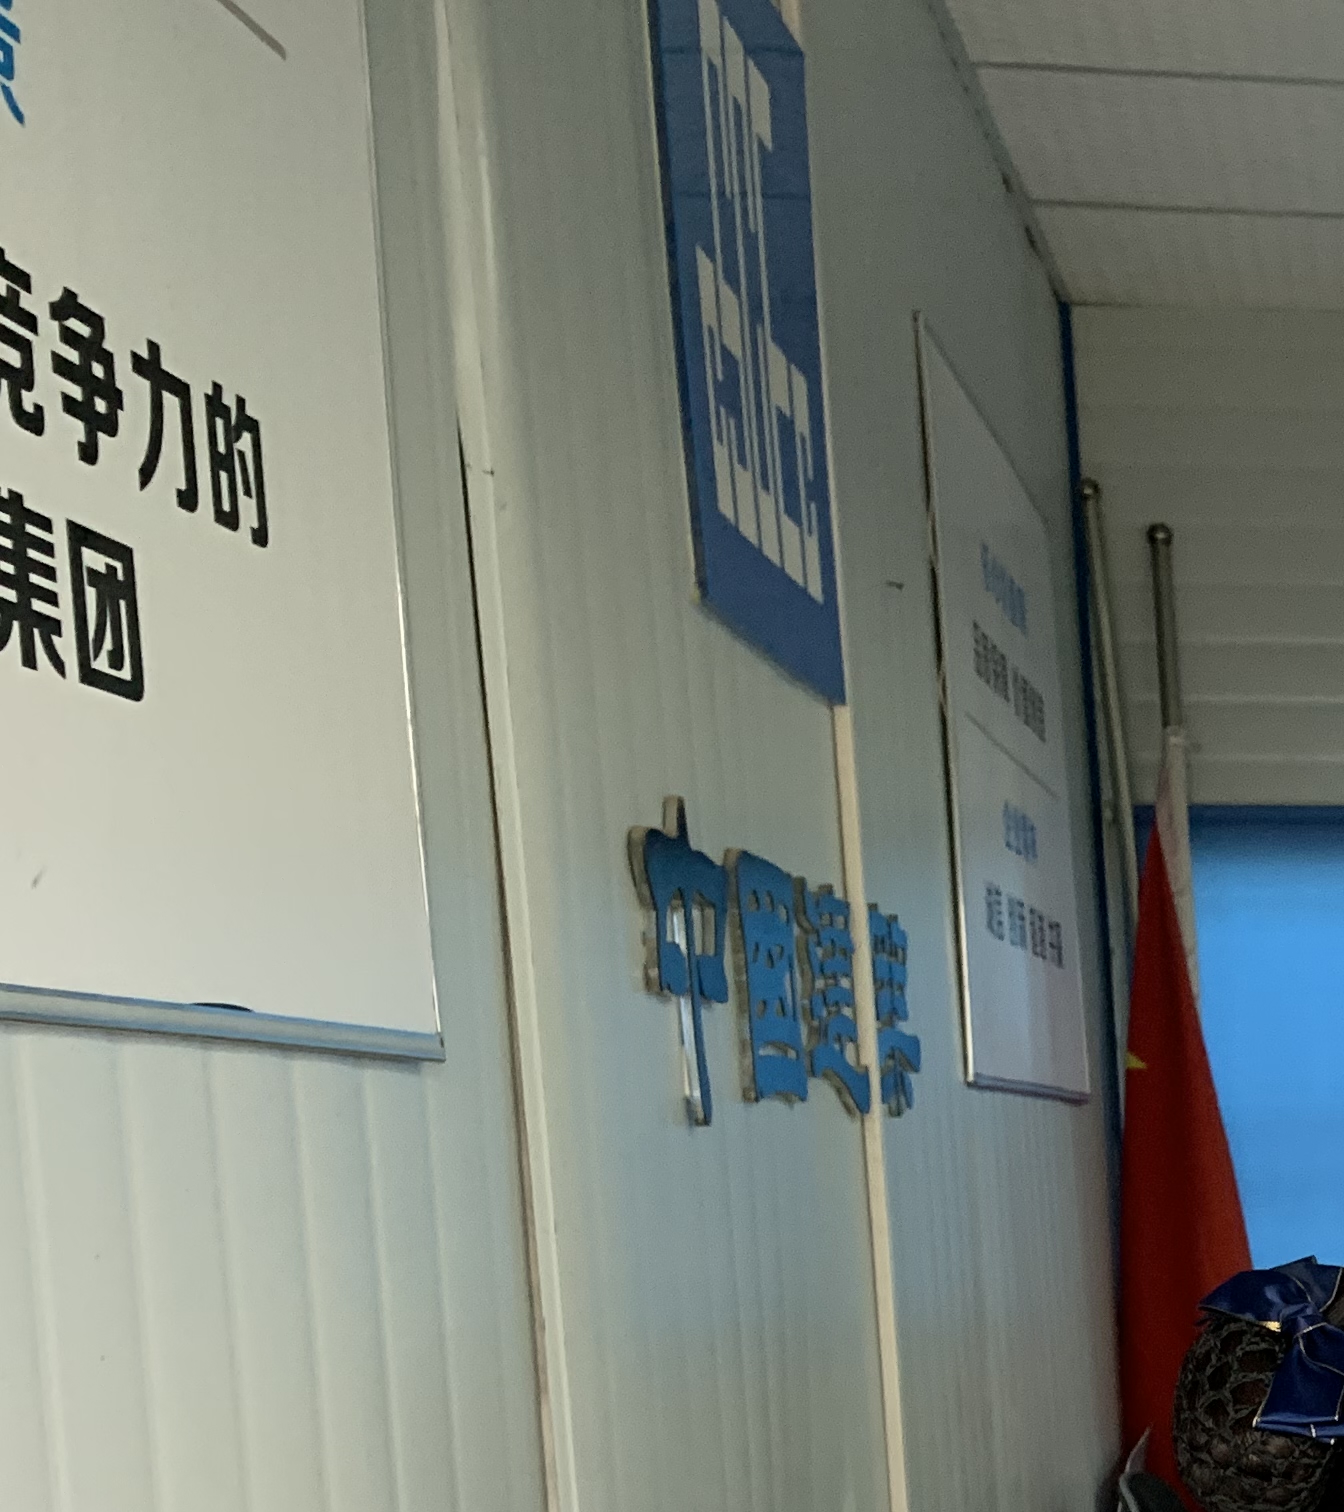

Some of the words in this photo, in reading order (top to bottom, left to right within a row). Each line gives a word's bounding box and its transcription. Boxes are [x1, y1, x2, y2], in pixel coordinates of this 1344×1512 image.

[0, 245, 270, 548] 竞争力的
[0, 487, 145, 703] 集团
